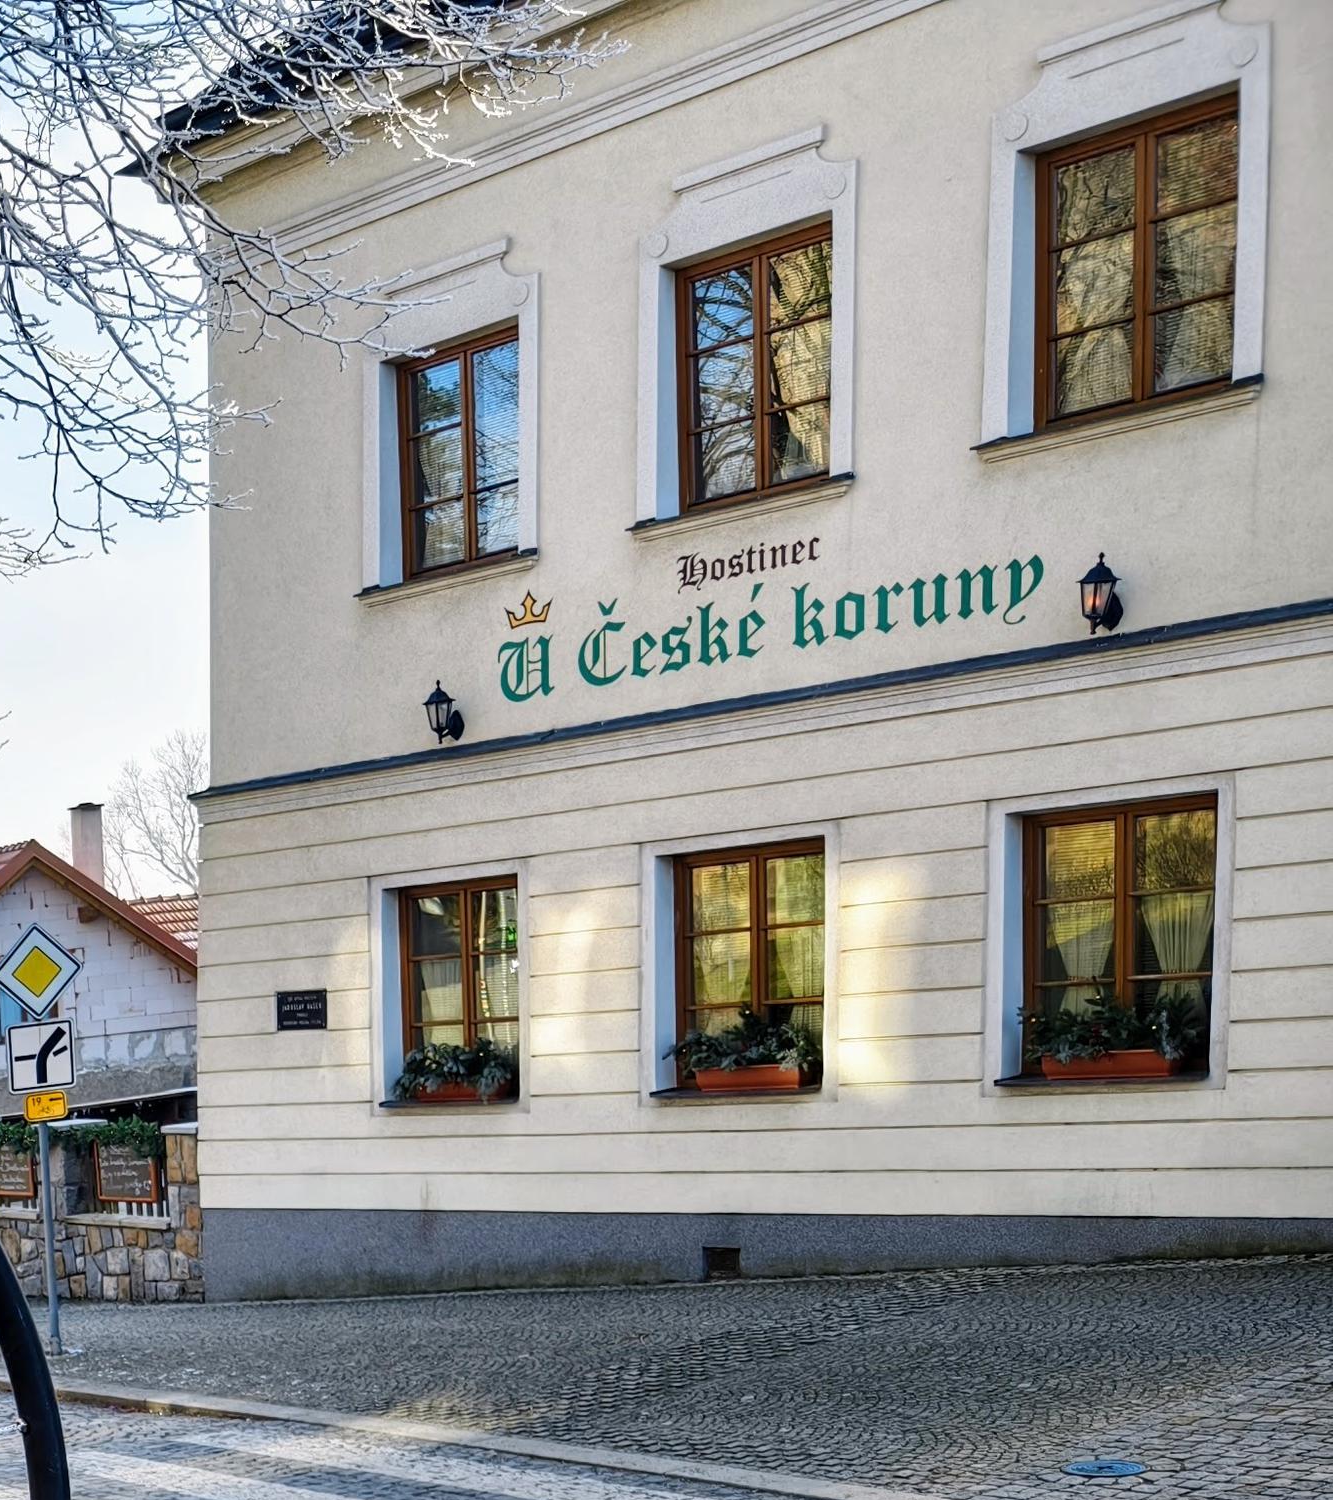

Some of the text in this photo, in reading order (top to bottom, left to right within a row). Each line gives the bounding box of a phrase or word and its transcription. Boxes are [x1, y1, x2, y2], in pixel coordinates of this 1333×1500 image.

[677, 536, 821, 595] Hostinec
[497, 554, 1045, 703] U České koruny
[32, 1097, 41, 1106] 19
